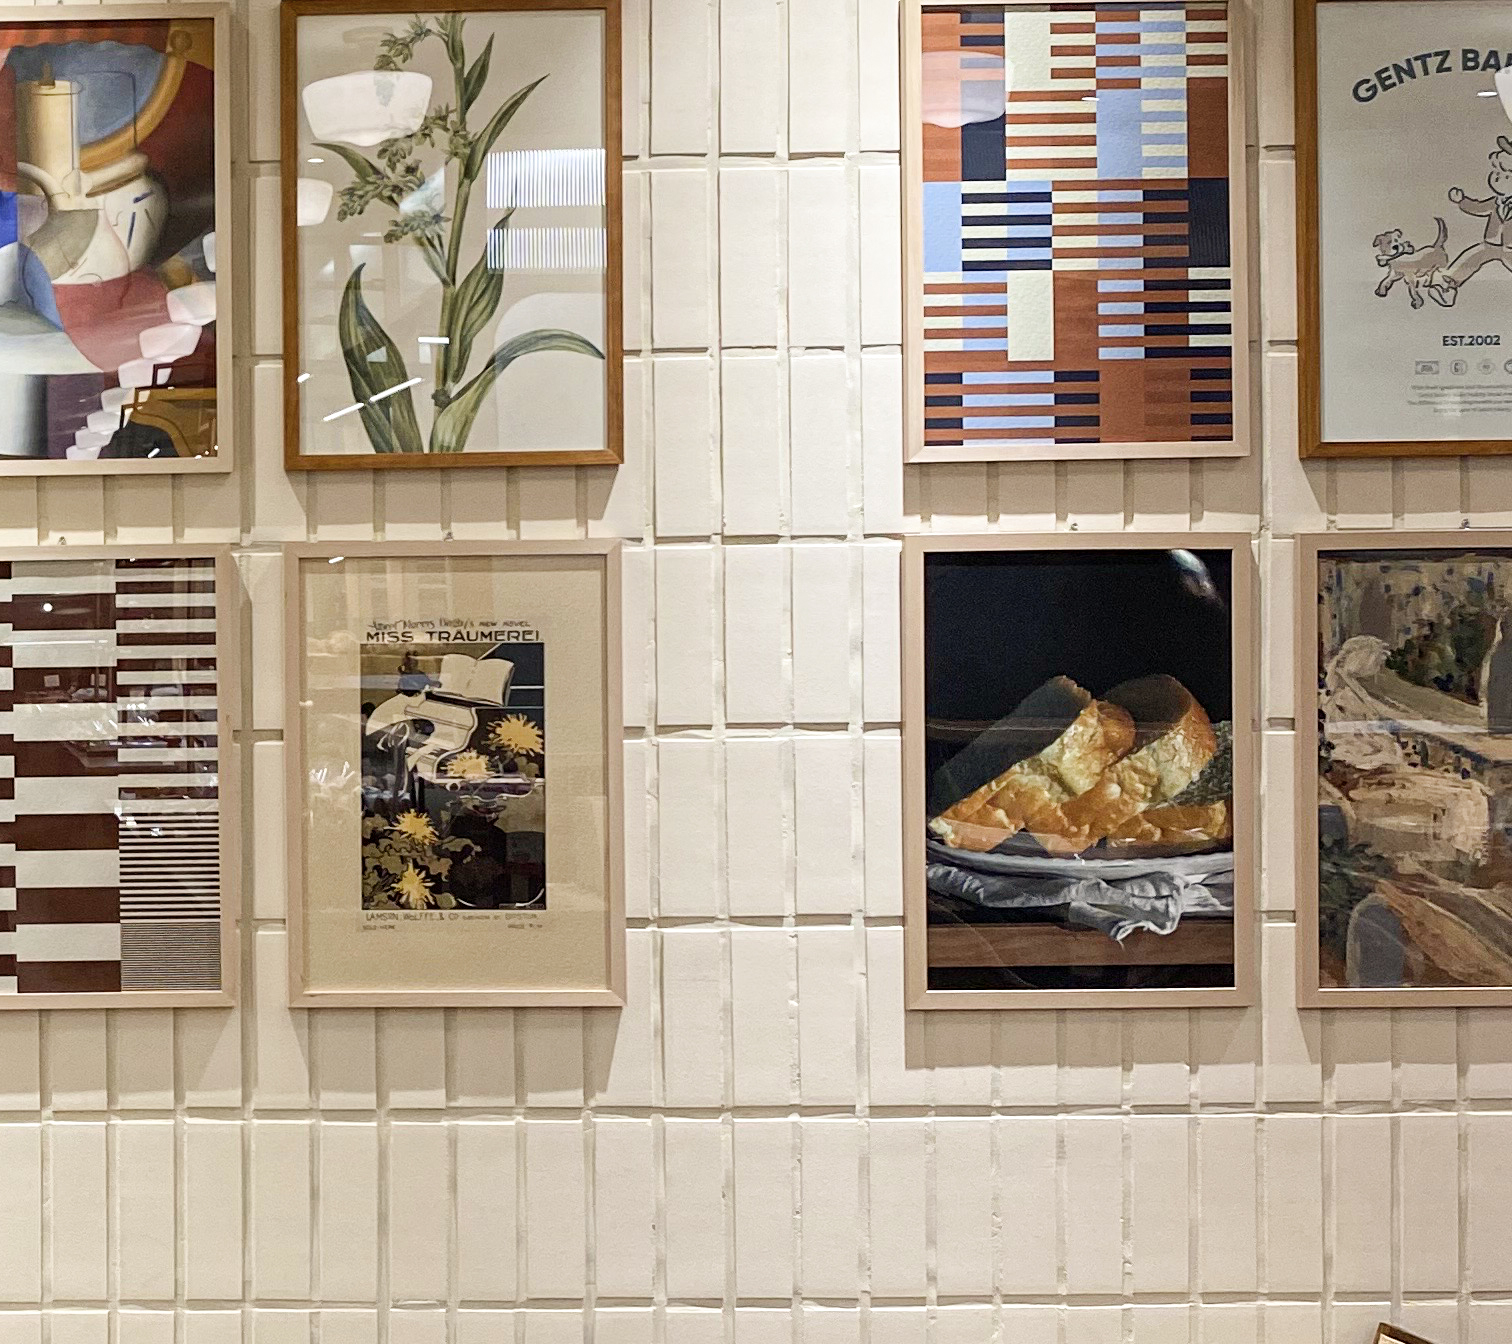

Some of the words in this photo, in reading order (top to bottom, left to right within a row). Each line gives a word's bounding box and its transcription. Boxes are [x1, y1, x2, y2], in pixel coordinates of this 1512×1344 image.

[1352, 49, 1453, 103] GENTZ
[1442, 335, 1501, 347] EST.2002
[366, 630, 414, 643] MISS
